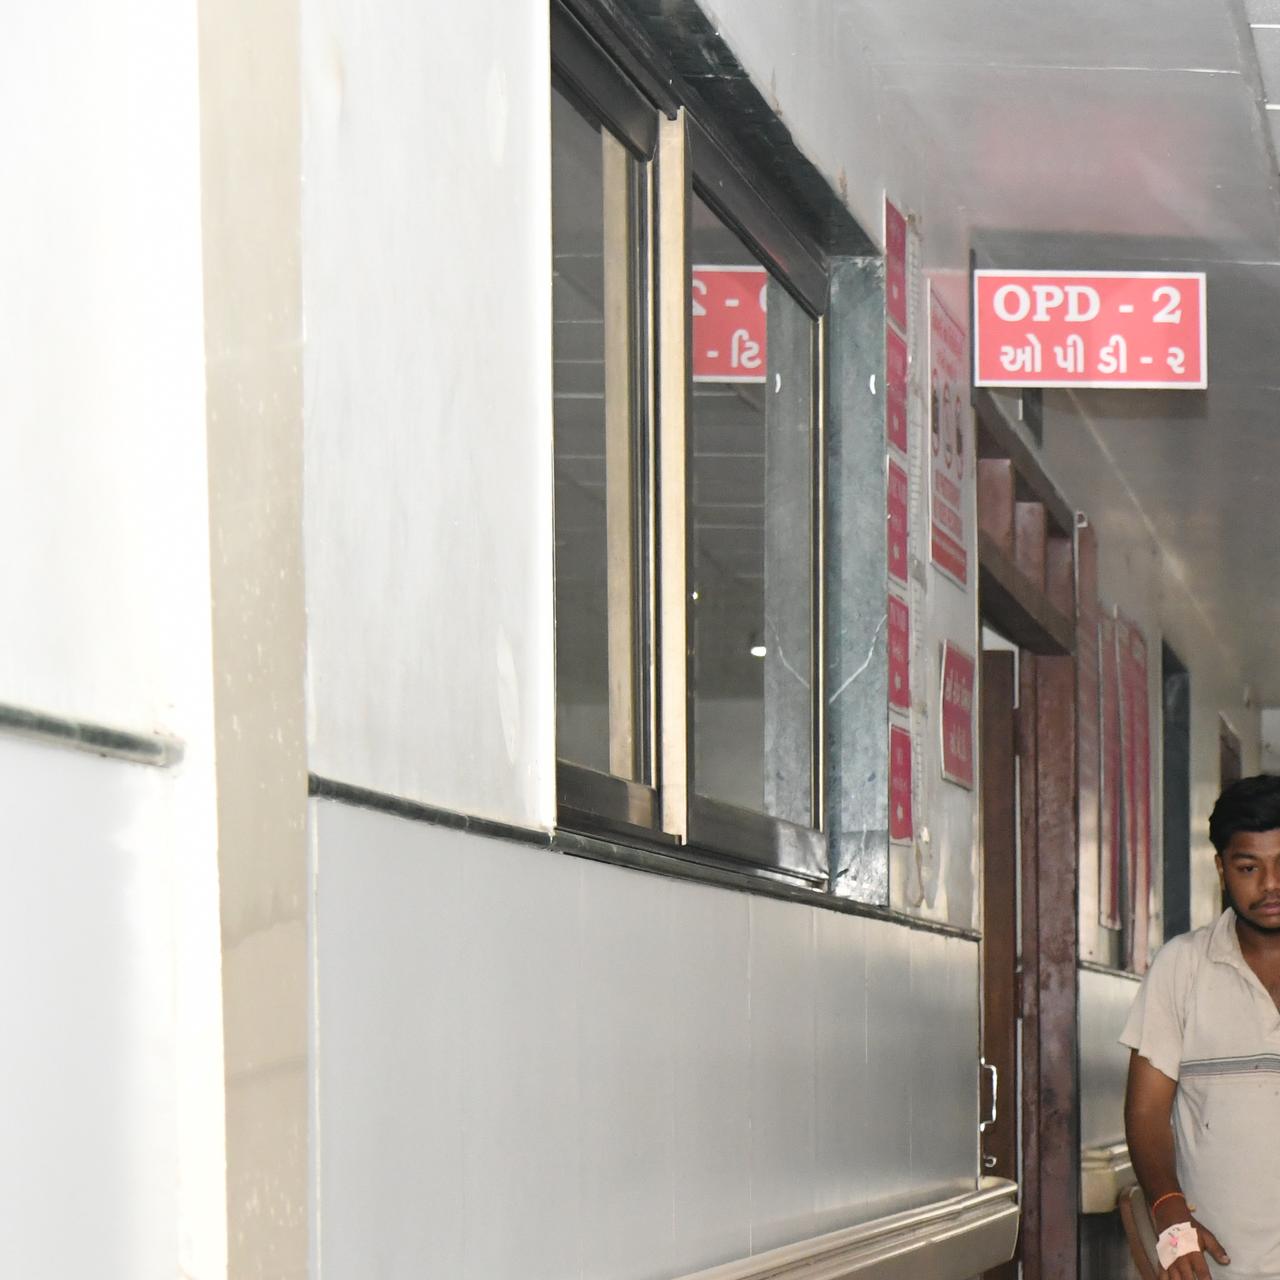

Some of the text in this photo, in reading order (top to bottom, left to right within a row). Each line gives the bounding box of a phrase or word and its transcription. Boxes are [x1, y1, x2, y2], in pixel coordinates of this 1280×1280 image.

[993, 284, 1182, 324] OPD - 2
[1000, 333, 1042, 373] ઓ
[1053, 334, 1085, 373] પી
[1097, 334, 1128, 374] ડી
[1139, 356, 1153, 364] -
